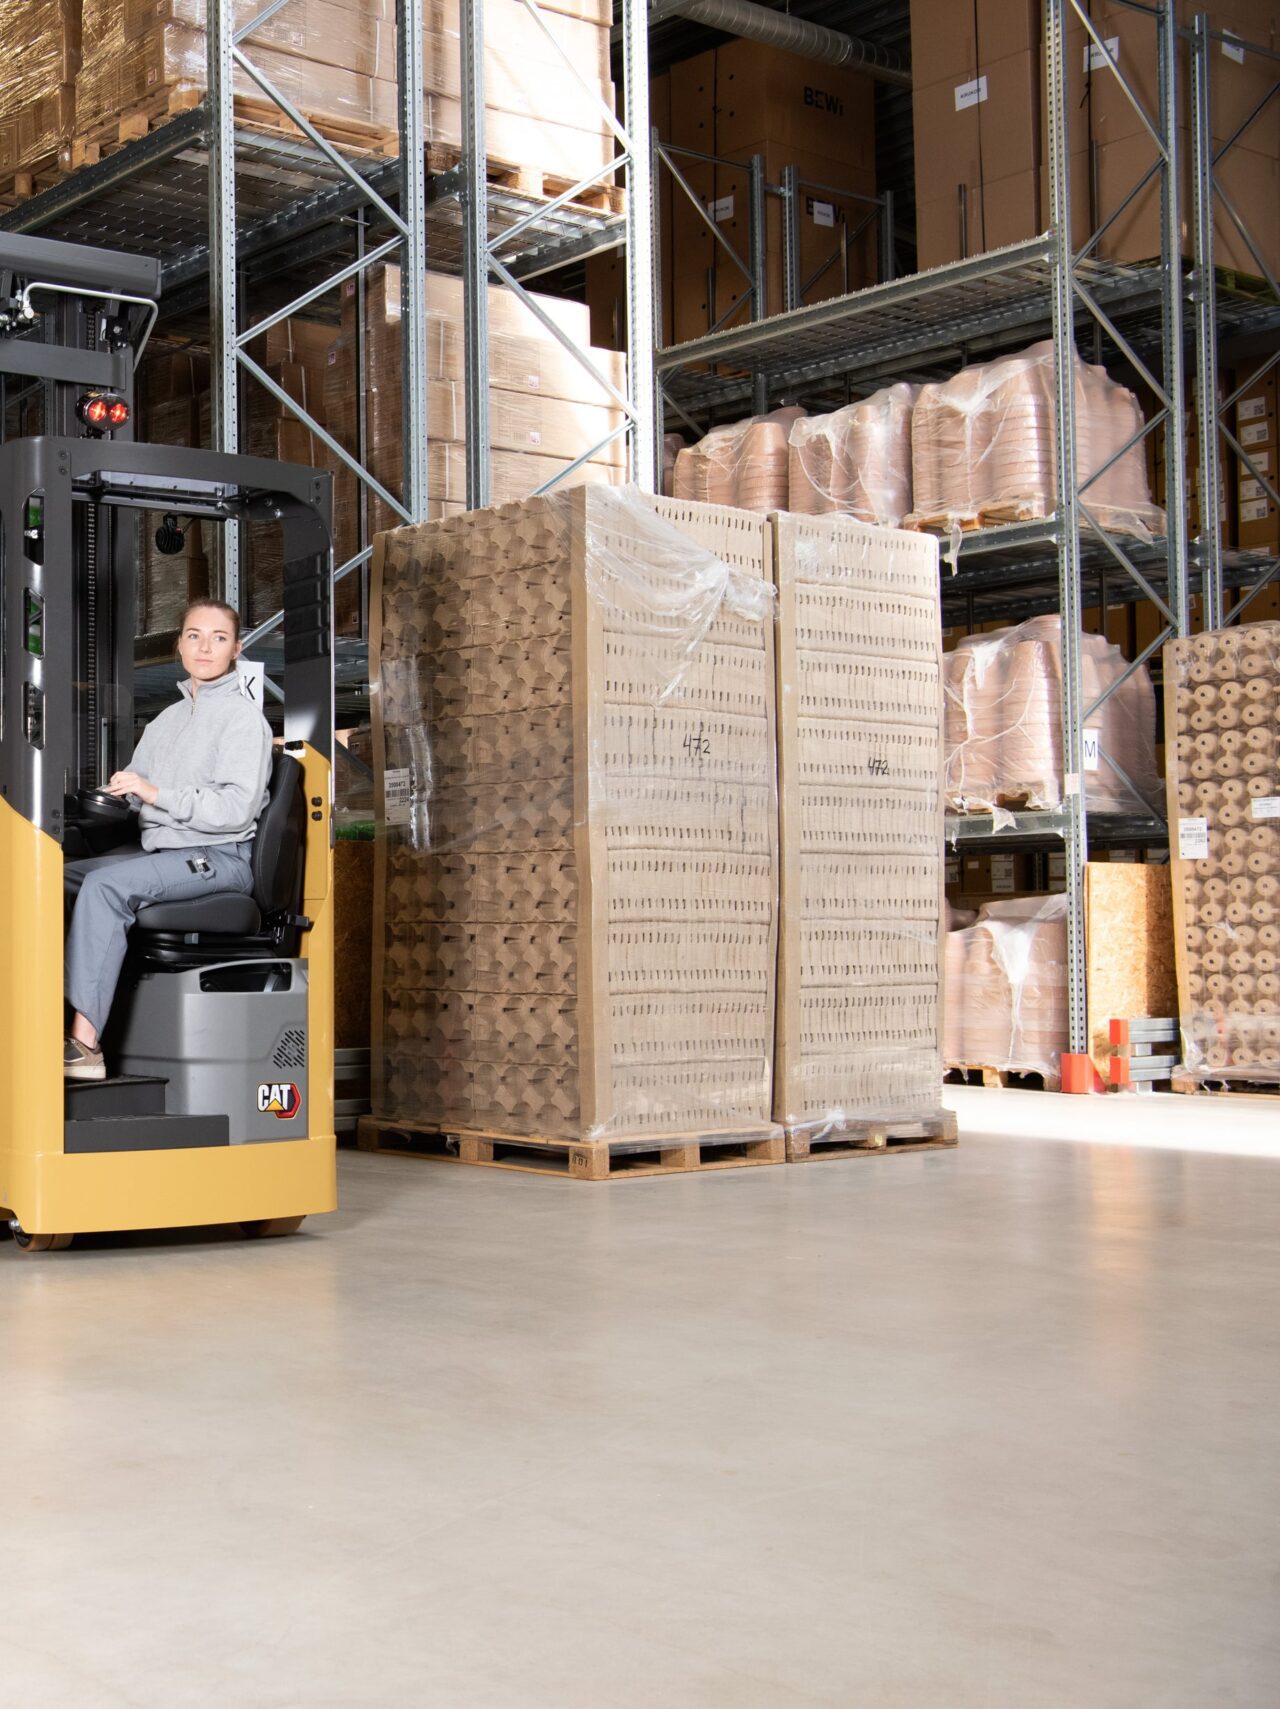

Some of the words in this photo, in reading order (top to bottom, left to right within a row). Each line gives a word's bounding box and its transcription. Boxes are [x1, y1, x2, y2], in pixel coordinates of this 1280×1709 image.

[683, 734, 710, 756] 472
[1084, 740, 1096, 758] M
[868, 757, 889, 776] 472
[257, 1083, 292, 1112] CAT
